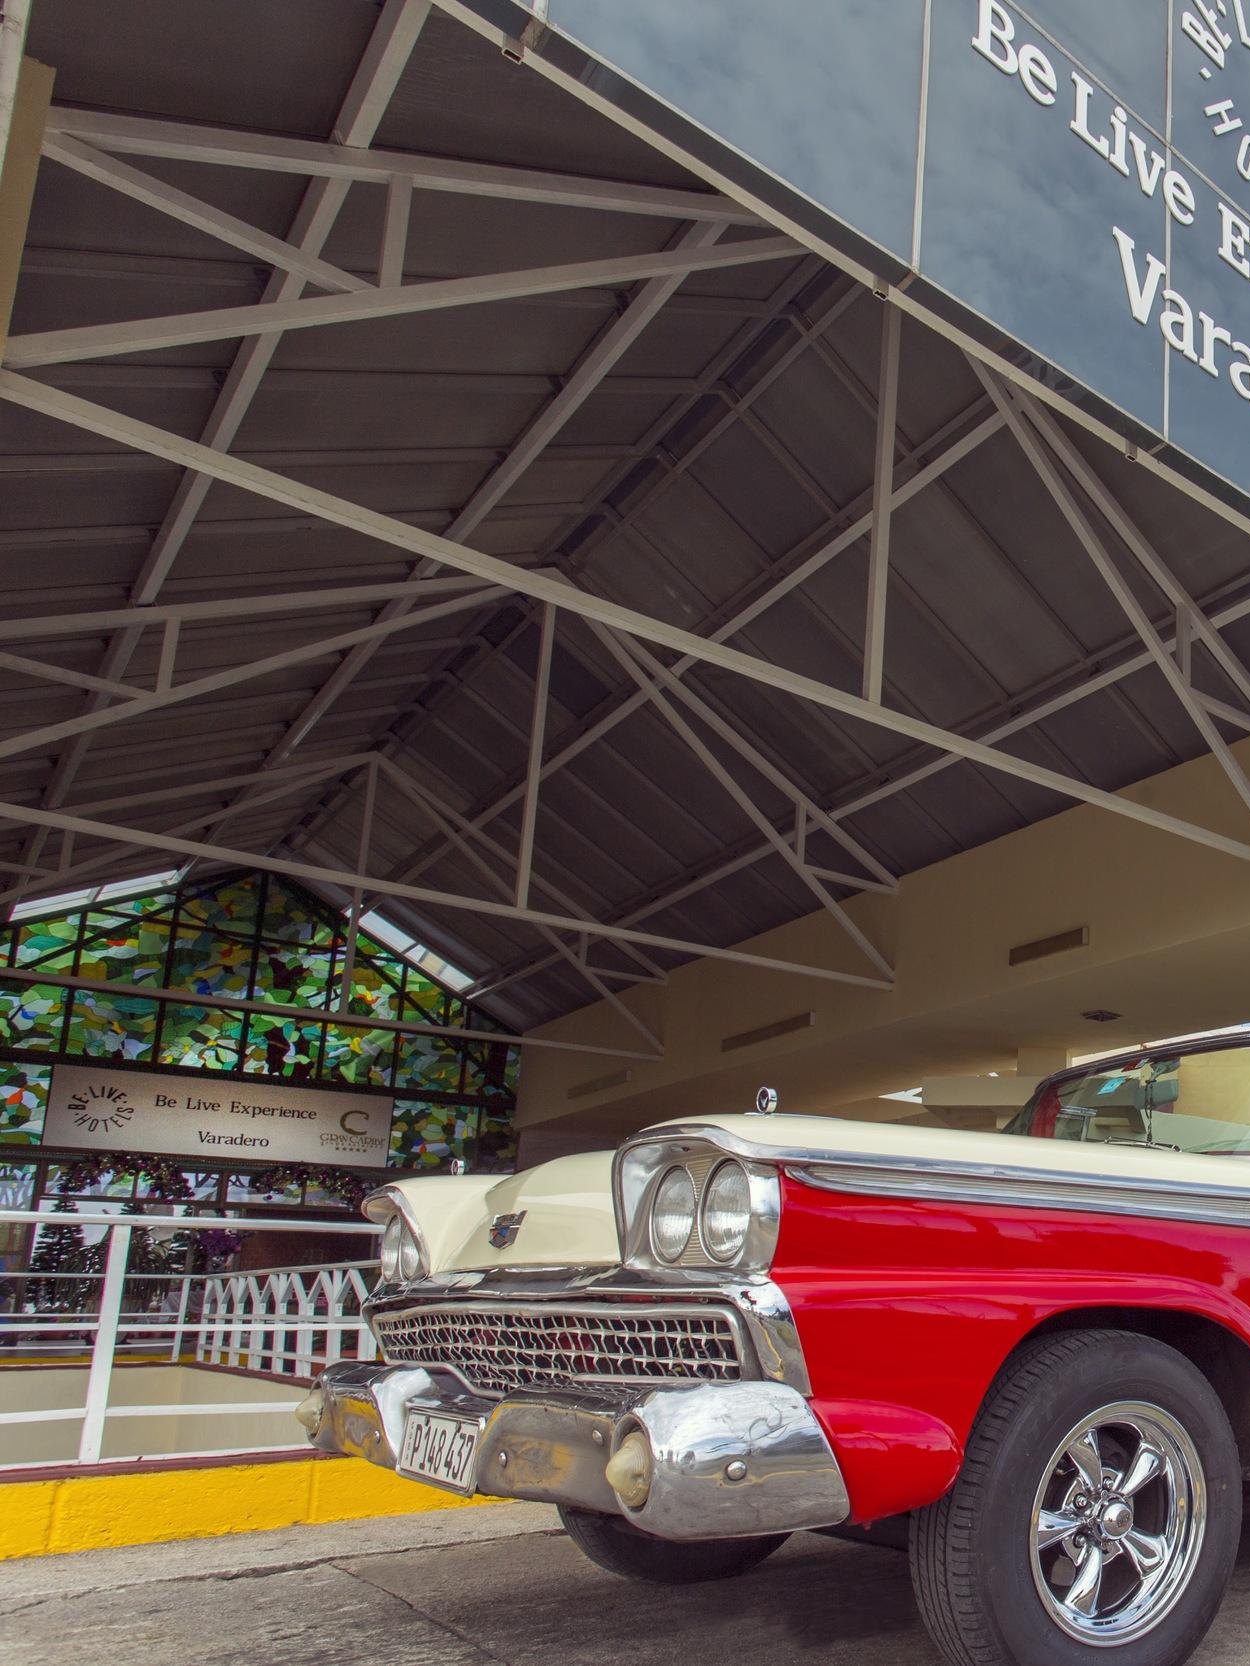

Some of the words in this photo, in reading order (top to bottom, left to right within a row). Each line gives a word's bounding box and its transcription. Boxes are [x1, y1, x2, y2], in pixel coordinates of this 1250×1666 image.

[1182, 0, 1232, 69] BE
[971, 0, 1057, 106] Be
[1069, 71, 1196, 226] Live
[68, 1094, 89, 1111] BE
[88, 1086, 127, 1104] LIVE
[155, 1094, 177, 1108] Be
[186, 1097, 221, 1112] Live
[230, 1101, 318, 1120] Experience
[74, 1107, 135, 1133] HOTELS
[198, 1131, 270, 1148] Varadero
